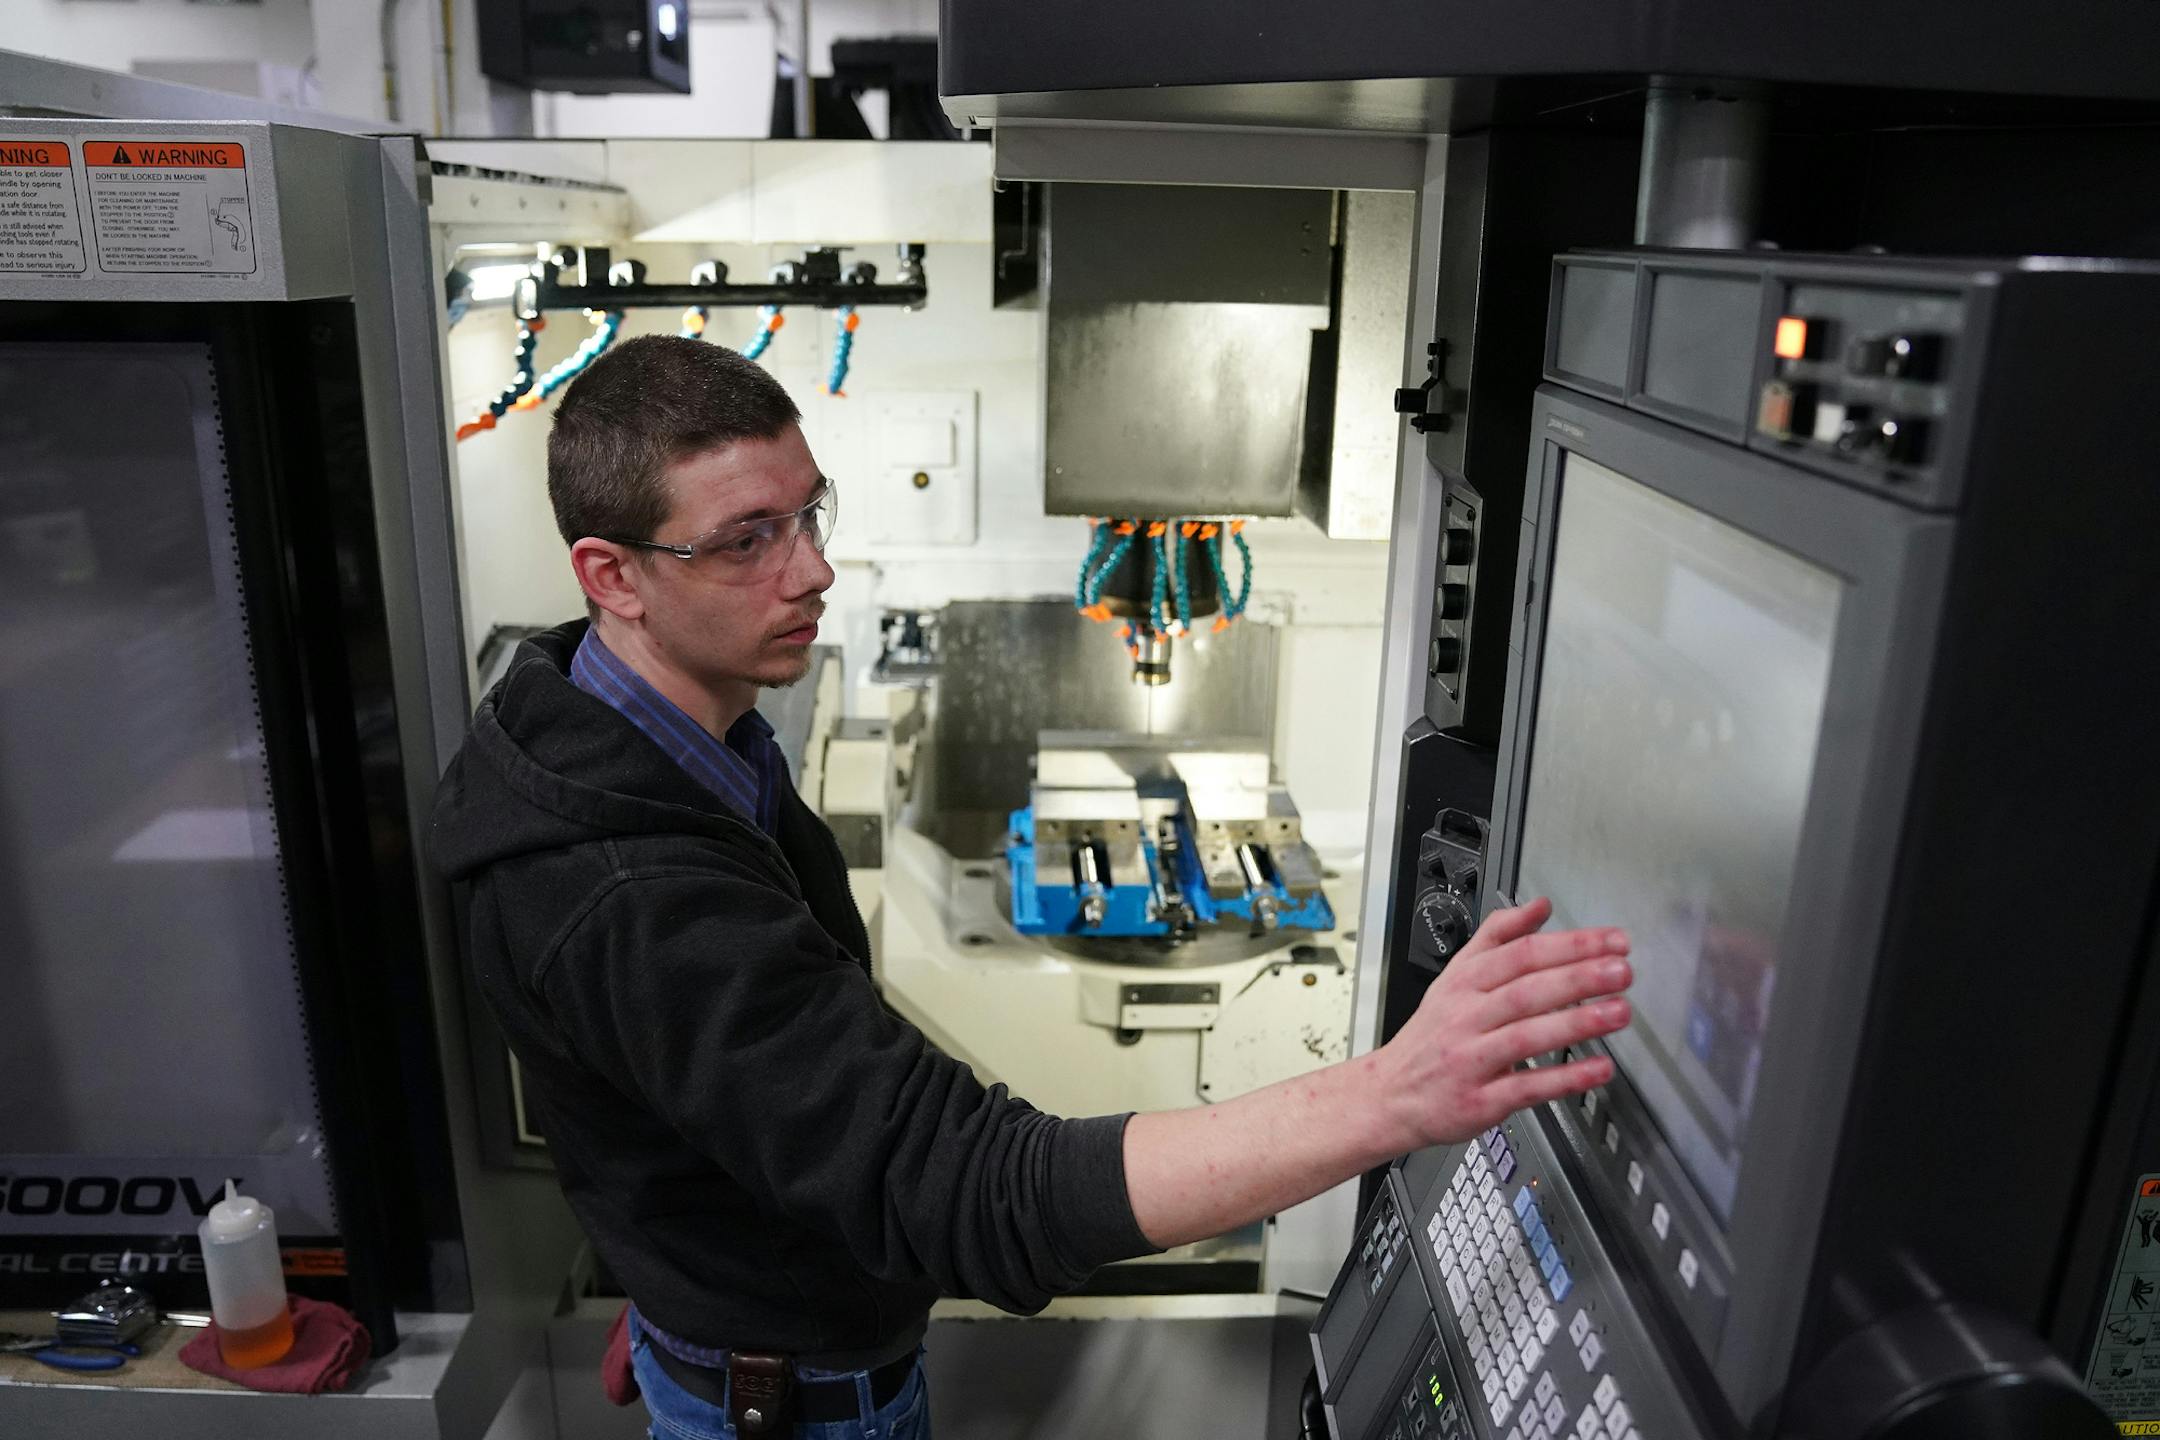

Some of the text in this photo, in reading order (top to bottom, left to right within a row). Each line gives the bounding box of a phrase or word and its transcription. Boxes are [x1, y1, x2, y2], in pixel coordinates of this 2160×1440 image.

[139, 149, 227, 165] WARNING
[14, 170, 23, 178] to
[25, 170, 38, 178] get
[39, 170, 63, 178] closer
[95, 172, 207, 181] DON'T BE LOCKED IN MACHINE
[20, 180, 29, 189] by
[32, 180, 62, 189] opening
[22, 201, 47, 210] distance
[6, 251, 15, 259] to
[17, 251, 47, 259] observe
[49, 251, 63, 259] this
[15, 261, 24, 270] to
[26, 261, 53, 270] serious
[58, 1252, 206, 1273] CENTE
[1429, 1374, 1443, 1407] 100
